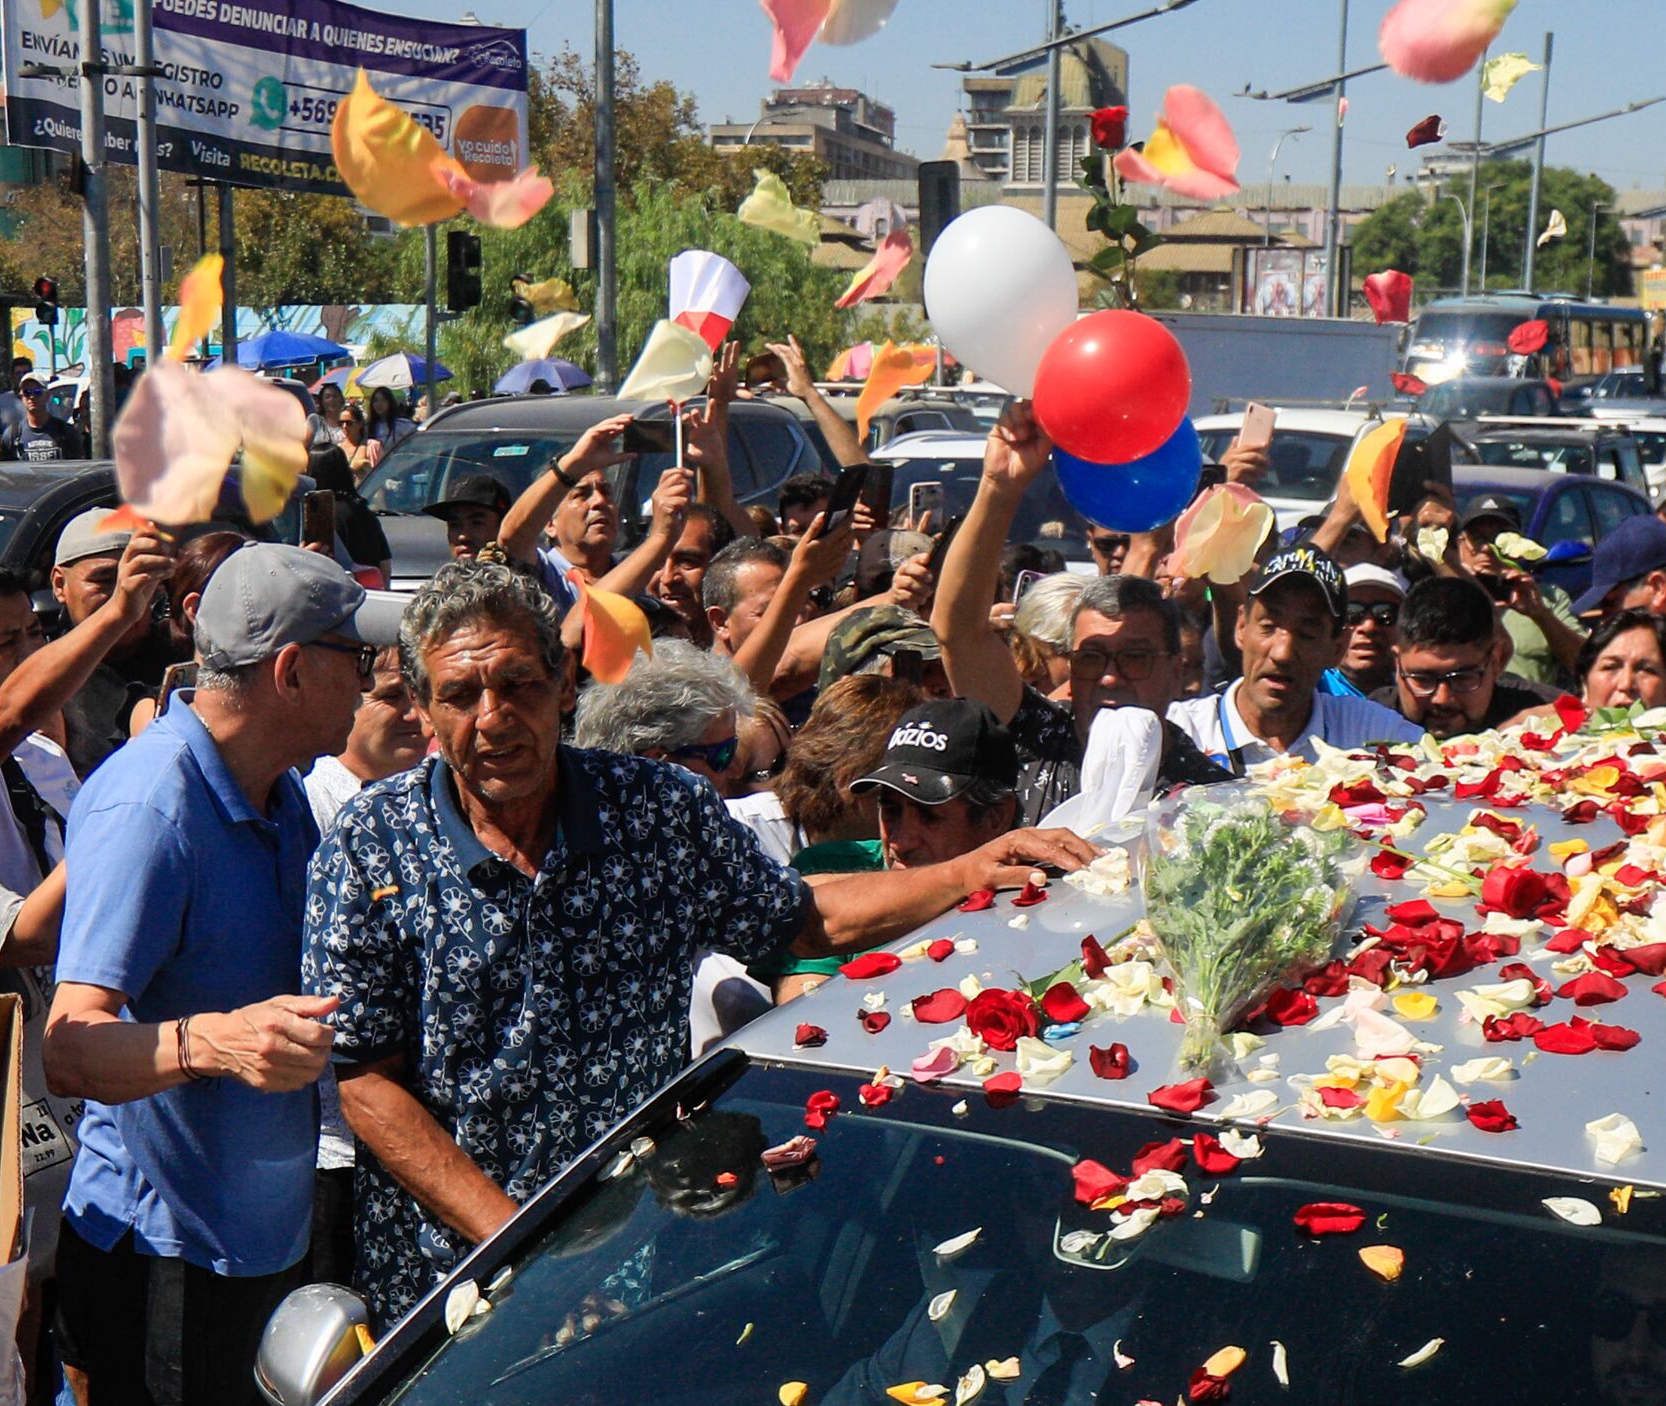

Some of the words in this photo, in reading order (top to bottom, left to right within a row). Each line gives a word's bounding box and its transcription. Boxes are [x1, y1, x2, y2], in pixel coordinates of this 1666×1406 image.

[219, 3, 308, 41] DENUNCIAR
[310, 21, 321, 42] A
[323, 24, 385, 55] QUIENES
[385, 37, 461, 65] ENSUCIAN?
[21, 31, 109, 65] ENVÍANS
[153, 60, 223, 90] EGISTRO
[33, 117, 83, 142] ¿Quiere
[191, 140, 231, 167] Visita
[22, 1122, 56, 1148] Na
[36, 1104, 48, 1118] 11
